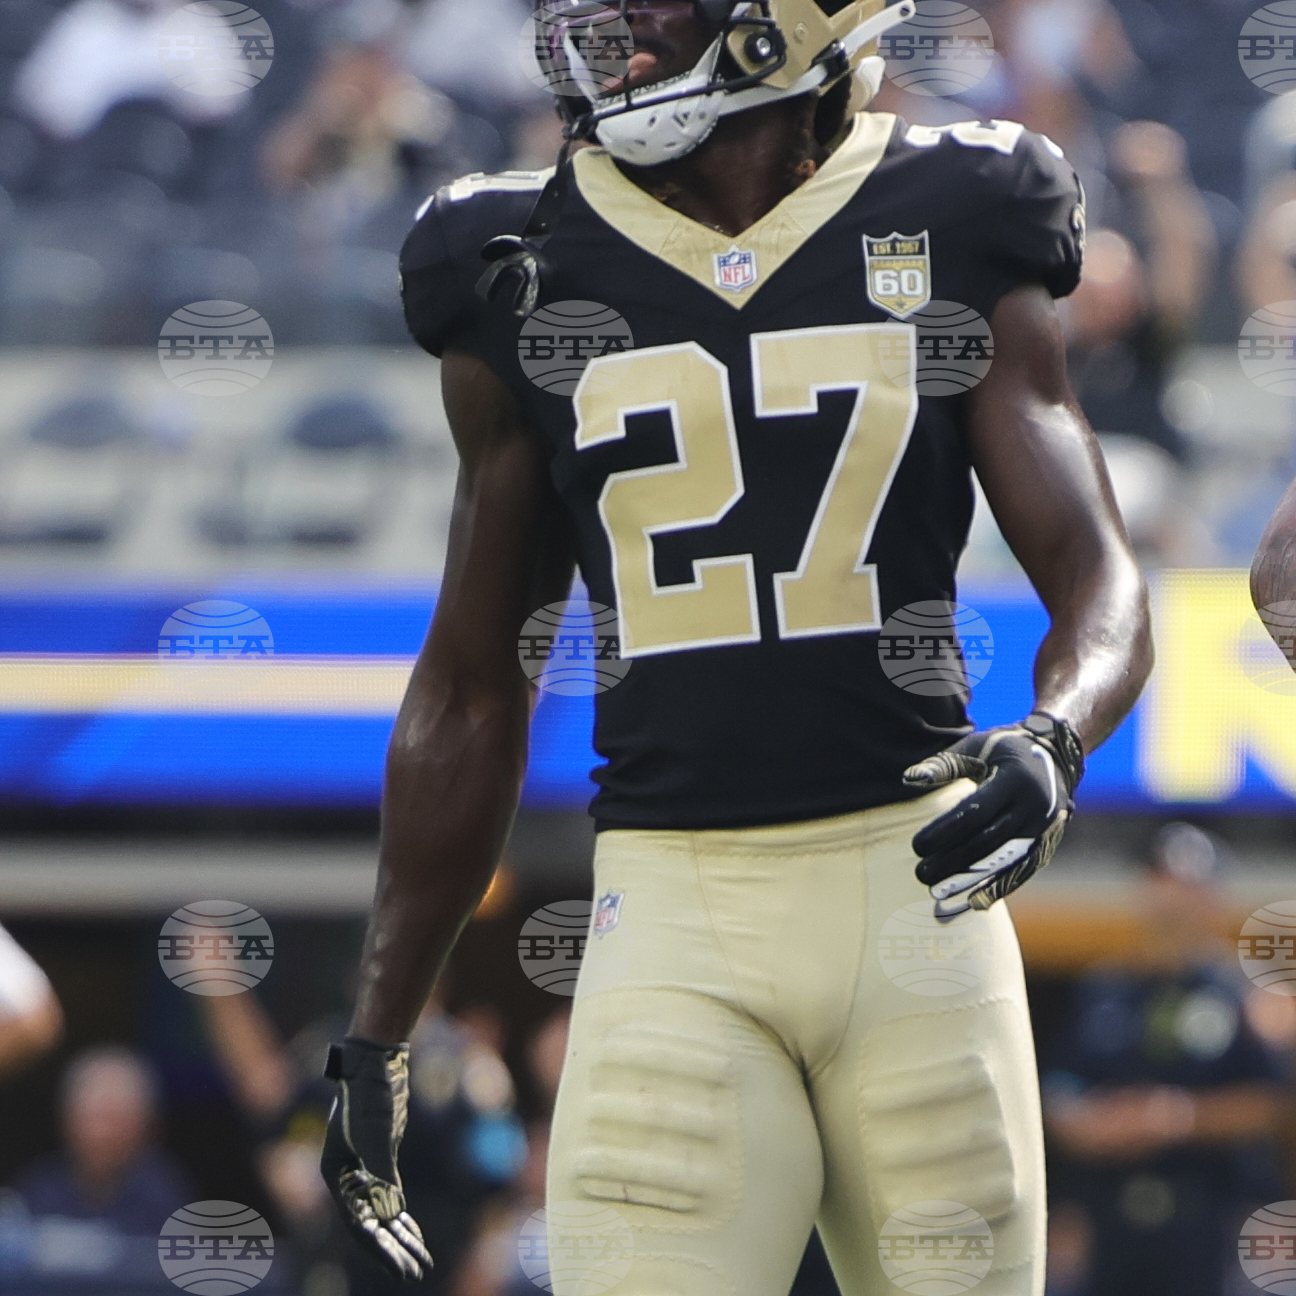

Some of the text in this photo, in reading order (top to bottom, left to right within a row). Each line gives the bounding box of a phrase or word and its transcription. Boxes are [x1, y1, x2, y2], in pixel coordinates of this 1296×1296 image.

[722, 265, 752, 284] NFL
[874, 269, 925, 296] 60
[573, 323, 919, 658] 27
